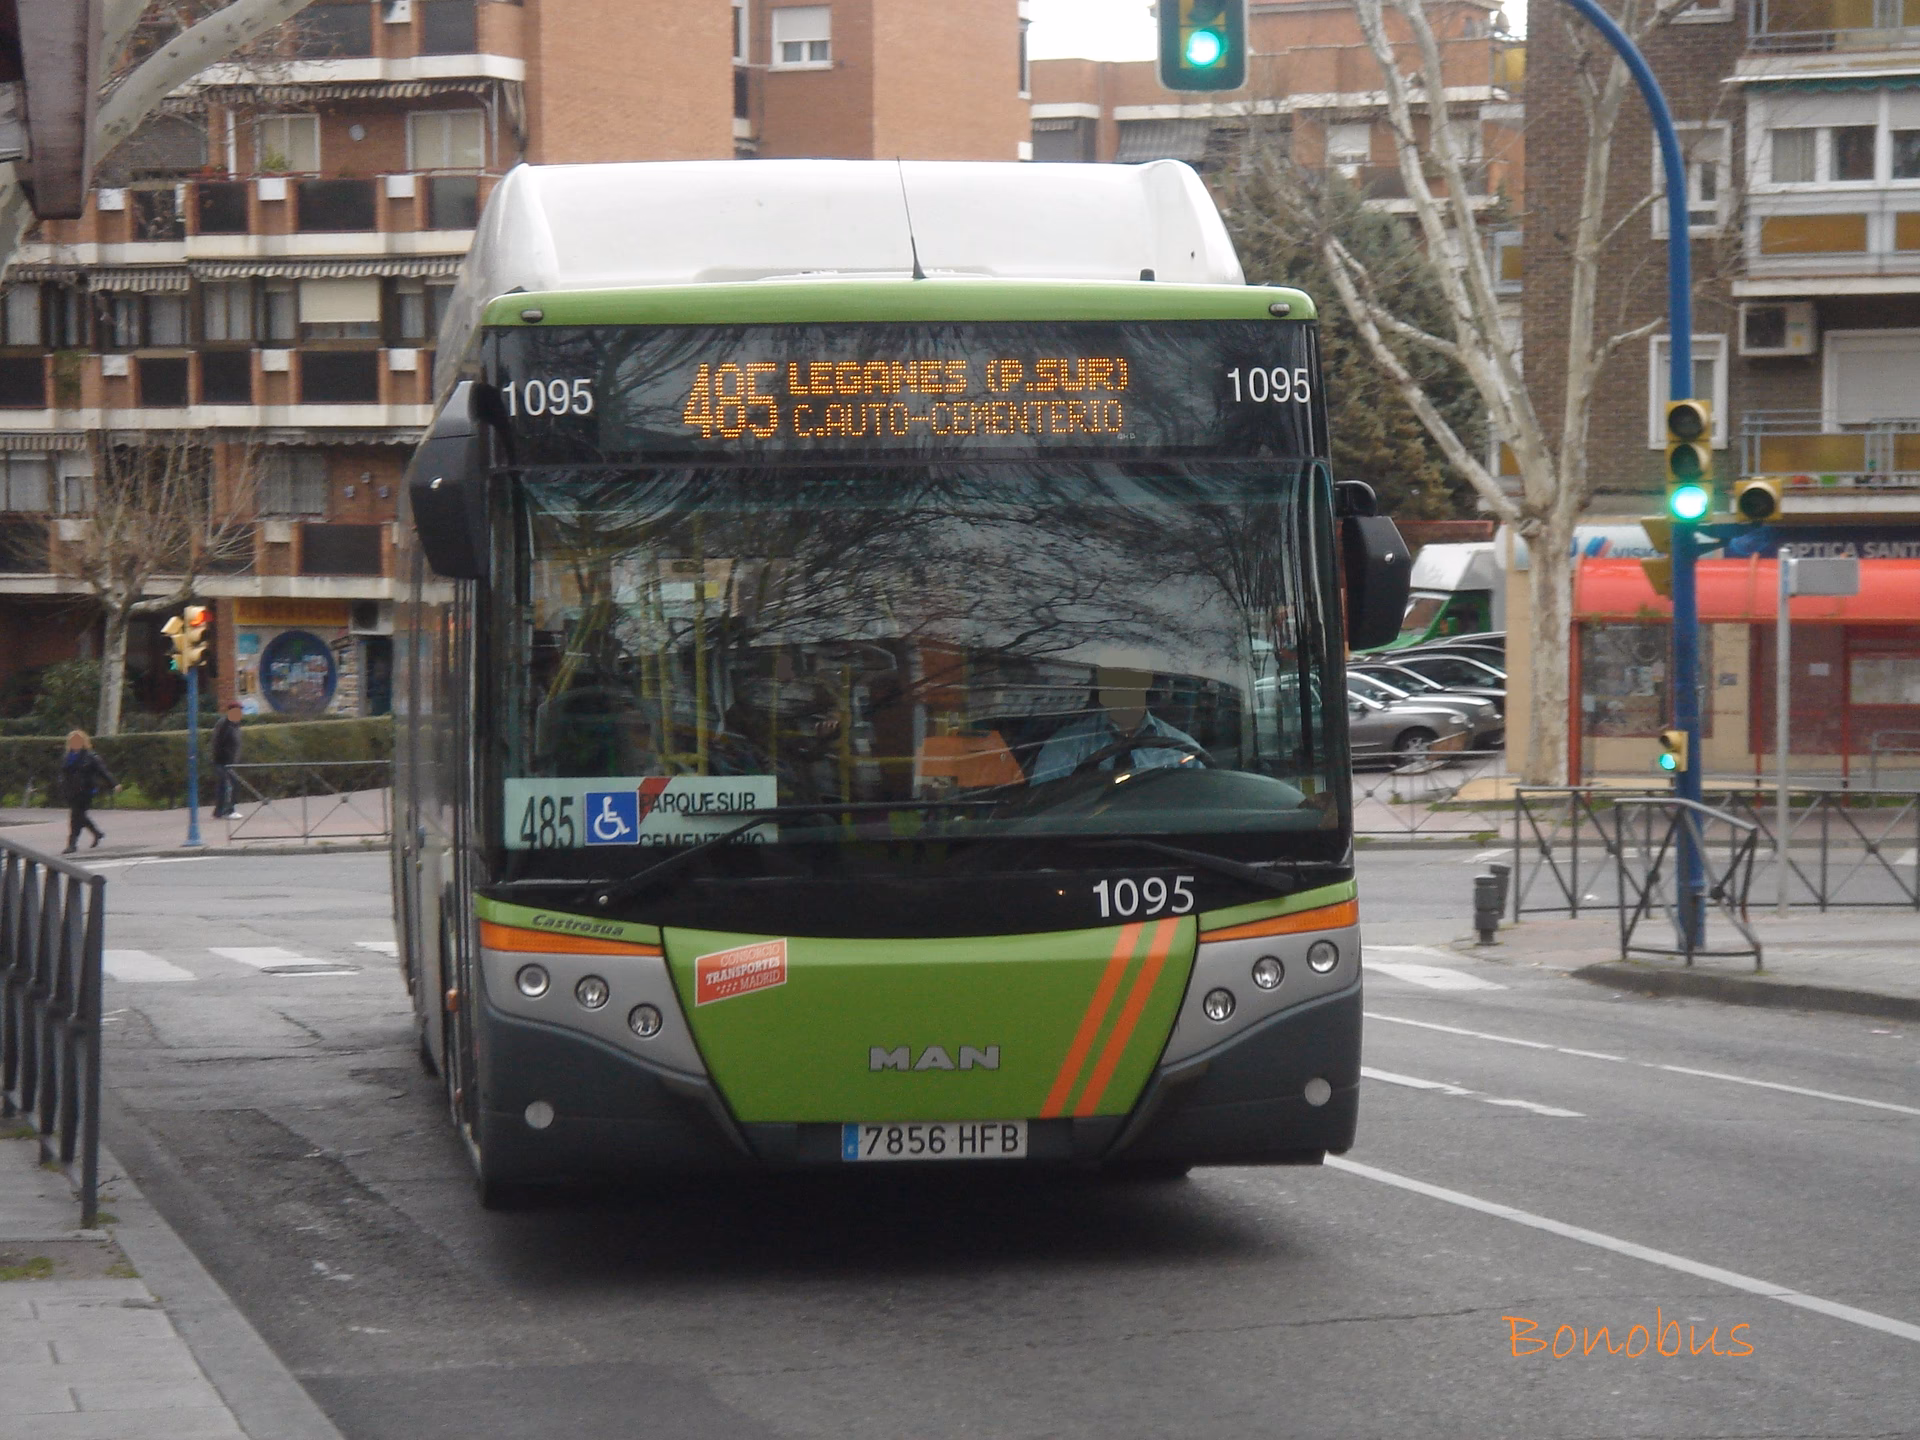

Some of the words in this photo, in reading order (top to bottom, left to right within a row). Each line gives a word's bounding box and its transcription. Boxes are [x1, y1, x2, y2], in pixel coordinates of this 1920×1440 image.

[788, 360, 967, 395] LEGANES
[986, 358, 1129, 392] (P.SUR)
[1227, 367, 1311, 403] 1095
[502, 378, 593, 417] 1095
[683, 362, 779, 438] 485
[793, 400, 1123, 437] C.AUTO-CEMENTERIO
[520, 795, 575, 849] 485
[1092, 875, 1194, 917] 1095
[532, 913, 625, 937] Castrosua
[705, 956, 780, 985] TRANSPORTES
[720, 943, 780, 967] CONSORCIO
[740, 969, 780, 991] MADRID
[869, 1045, 1000, 1072] MAN
[865, 1125, 946, 1155] 7856
[958, 1123, 1018, 1154] HFB
